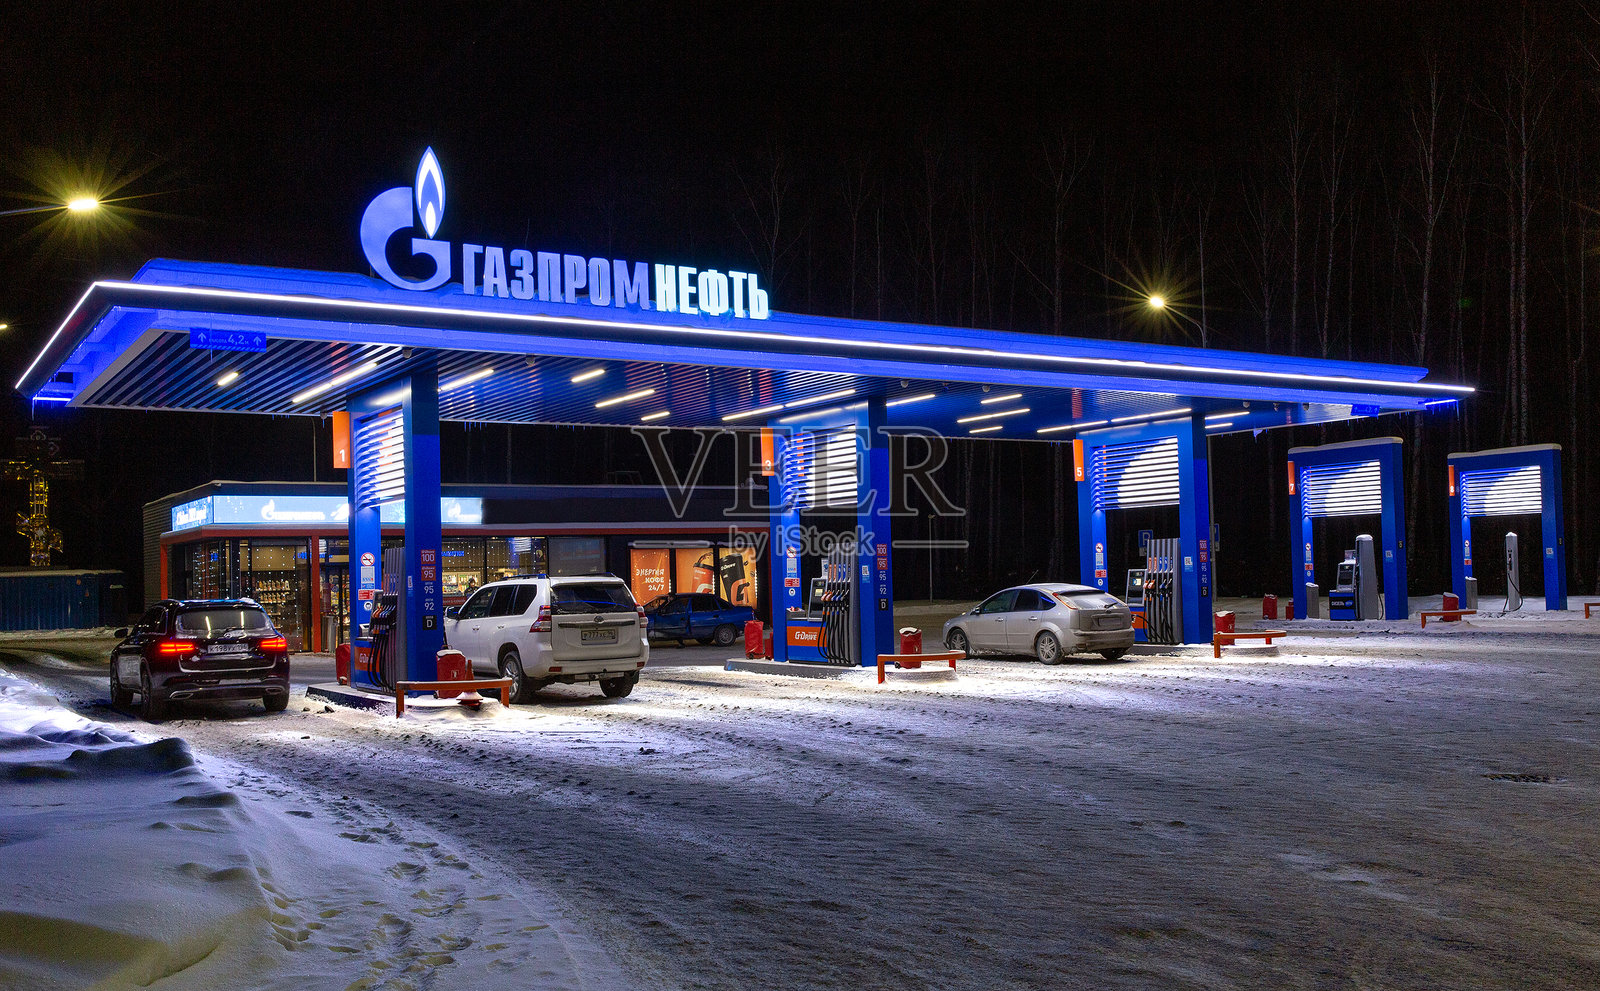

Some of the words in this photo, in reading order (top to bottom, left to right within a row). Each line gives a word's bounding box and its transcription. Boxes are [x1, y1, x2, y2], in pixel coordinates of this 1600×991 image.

[462, 243, 769, 320] ГАЗПРОМНЕФТЬ
[339, 449, 345, 463] 1
[764, 459, 772, 471] 3
[1076, 466, 1082, 477] 5
[1290, 483, 1295, 492] 7
[1142, 531, 1151, 546] P
[421, 553, 435, 562] 100
[423, 570, 434, 579] 95
[636, 568, 665, 576] ЭНЕРГИЯ
[423, 585, 434, 595] 95
[424, 601, 435, 611] 92
[426, 619, 433, 628] D
